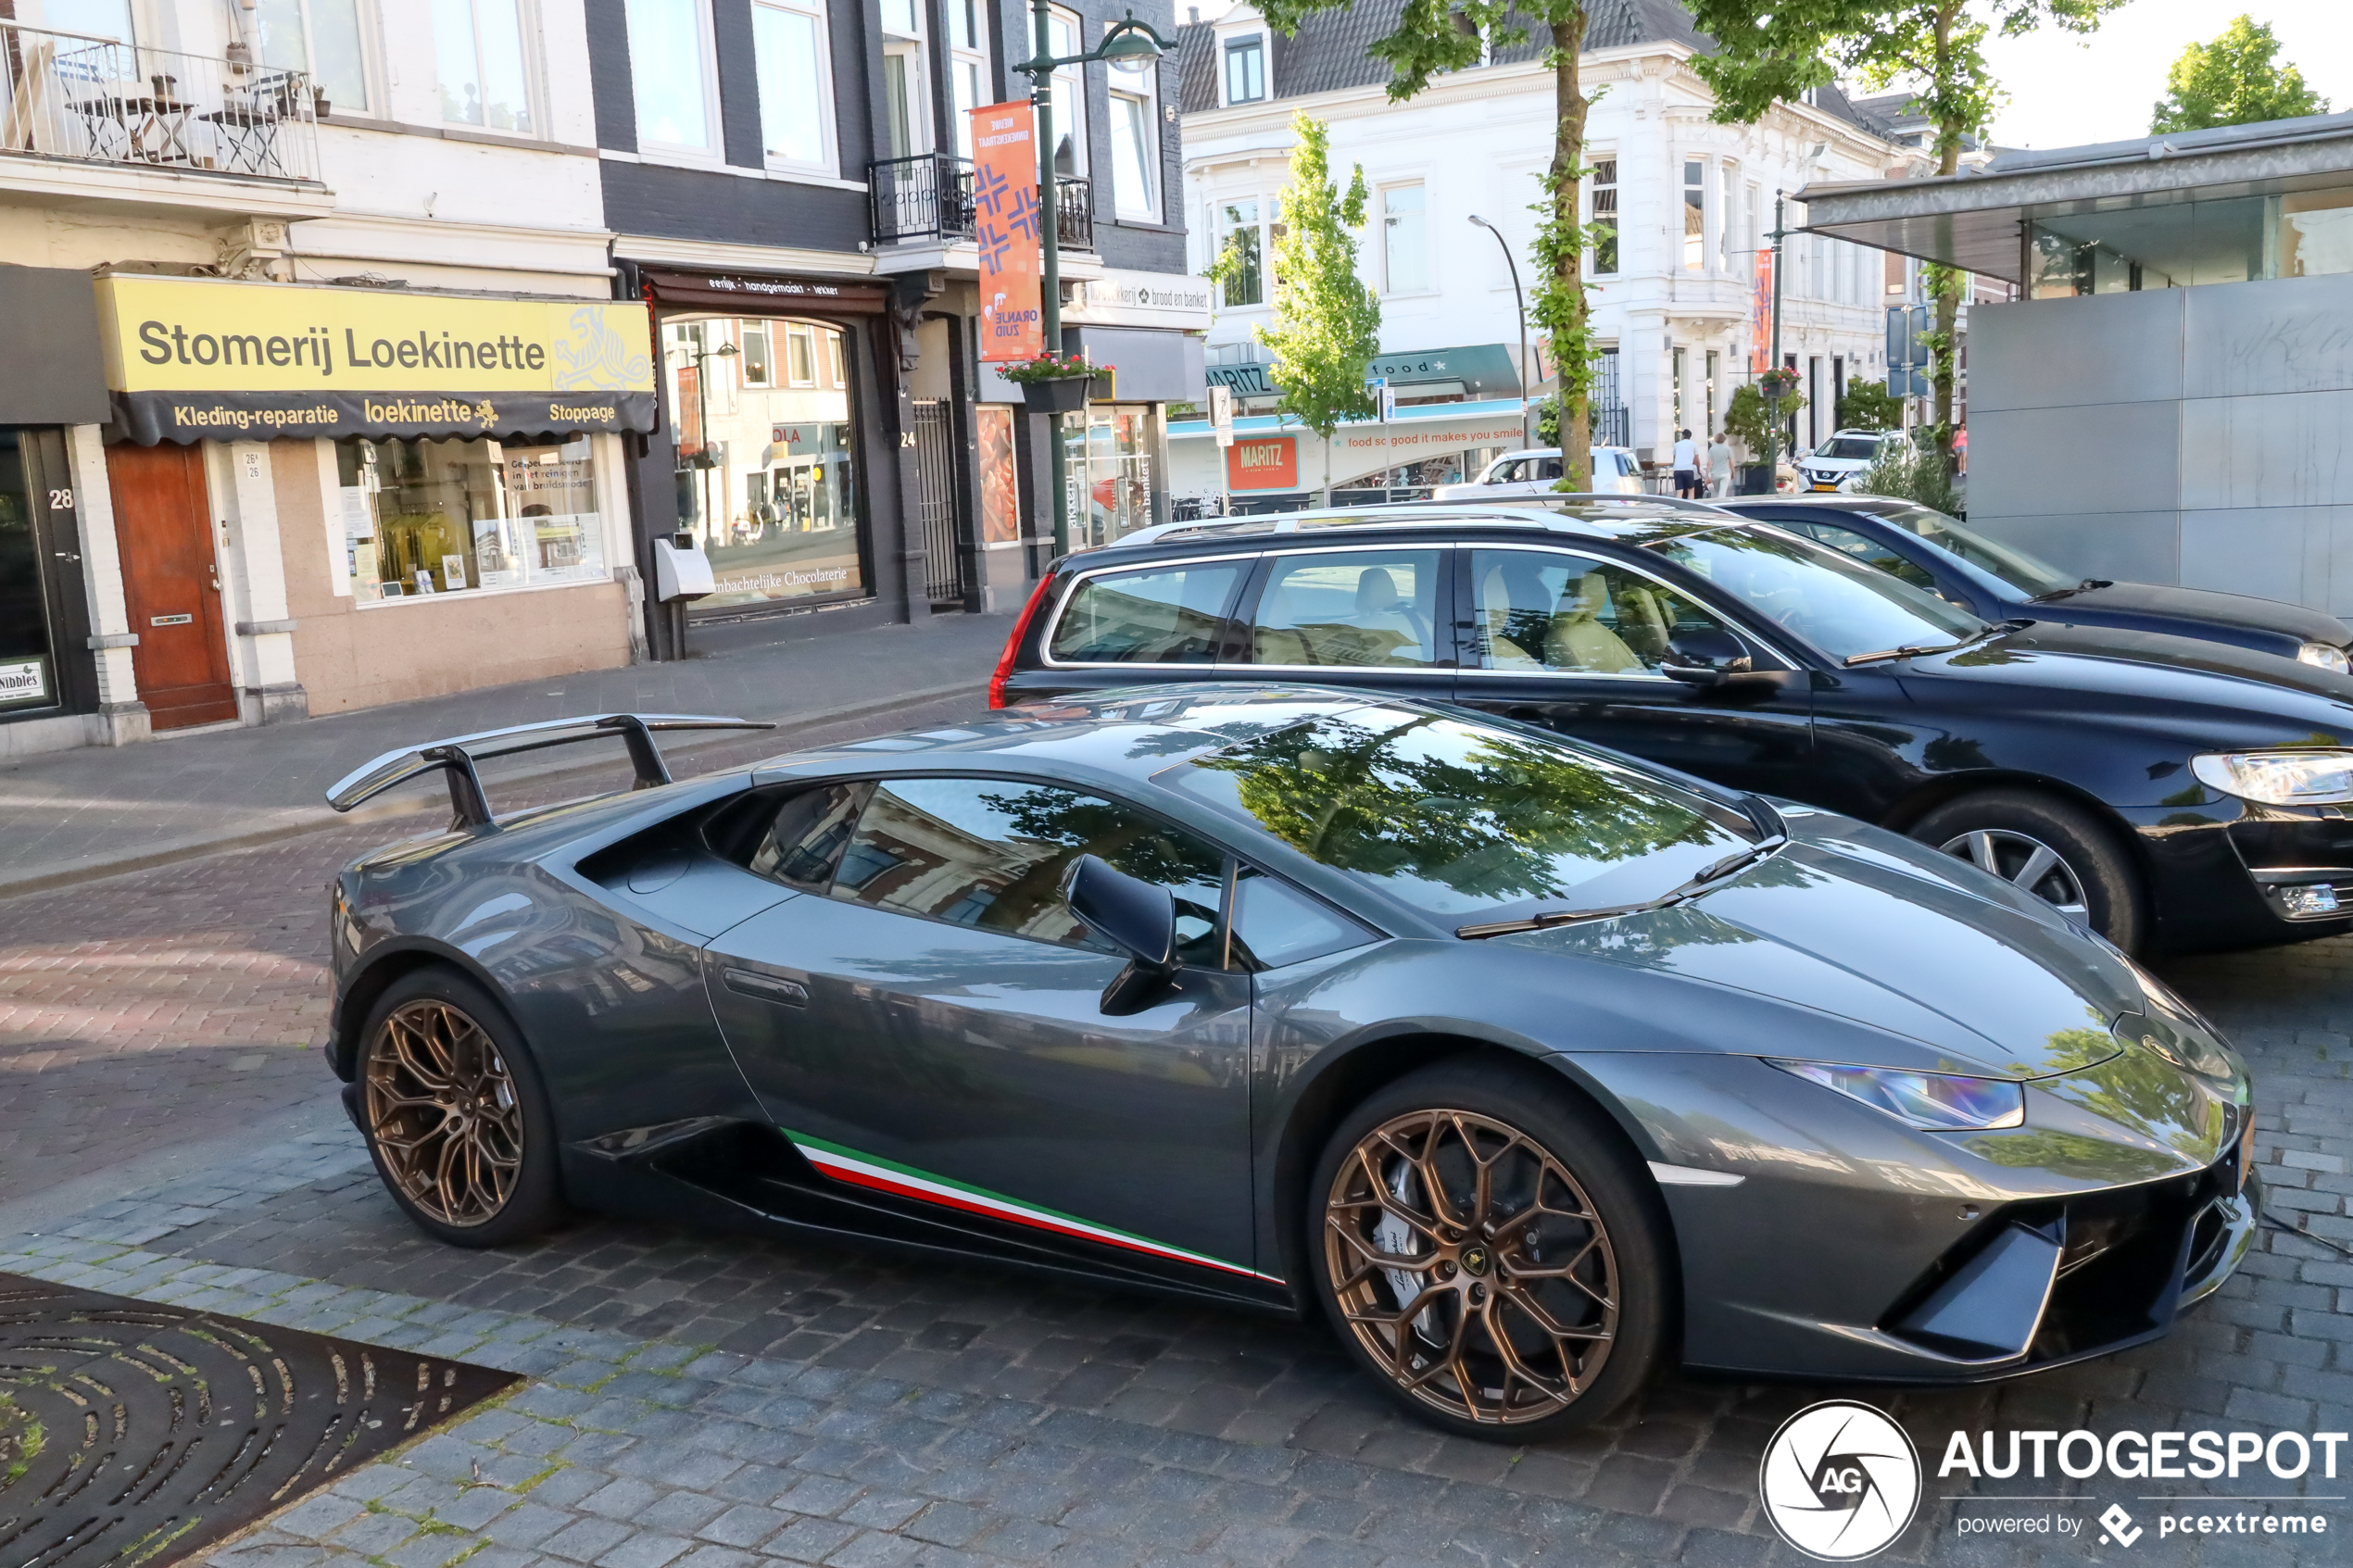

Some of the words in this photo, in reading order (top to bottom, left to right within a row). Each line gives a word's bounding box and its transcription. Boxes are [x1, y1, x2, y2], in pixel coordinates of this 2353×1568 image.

[710, 278, 736, 291] eerlijk
[744, 281, 804, 295] handgemaakt
[813, 285, 838, 295] lekker
[1151, 288, 1173, 307] brood
[1175, 295, 1183, 307] en
[1184, 291, 1208, 308] banket
[139, 320, 333, 376] Stomerij
[346, 328, 545, 370] Loekinette
[1372, 361, 1428, 375] food
[174, 405, 339, 430] Kleding-reparatie
[364, 399, 472, 423] loekinette
[549, 404, 615, 424] Stoppage
[901, 432, 916, 448] 24
[1349, 435, 1372, 448] food
[1375, 438, 1387, 446] so
[1390, 433, 1418, 447] good
[1421, 433, 1429, 444] it
[1432, 431, 1467, 444] makes
[1470, 432, 1491, 446] you
[1493, 427, 1523, 440] smile
[1240, 444, 1283, 469] MARITZ
[249, 467, 259, 478] 26
[512, 470, 522, 480] in
[542, 470, 579, 479] reinigen
[534, 480, 588, 490] bruidsmode
[1141, 461, 1151, 507] banket
[49, 488, 74, 509] 28
[1066, 475, 1077, 528] akkerij
[1145, 509, 1152, 525] en
[714, 572, 782, 594] mbachtelijke
[785, 567, 847, 585] Chocolaterie
